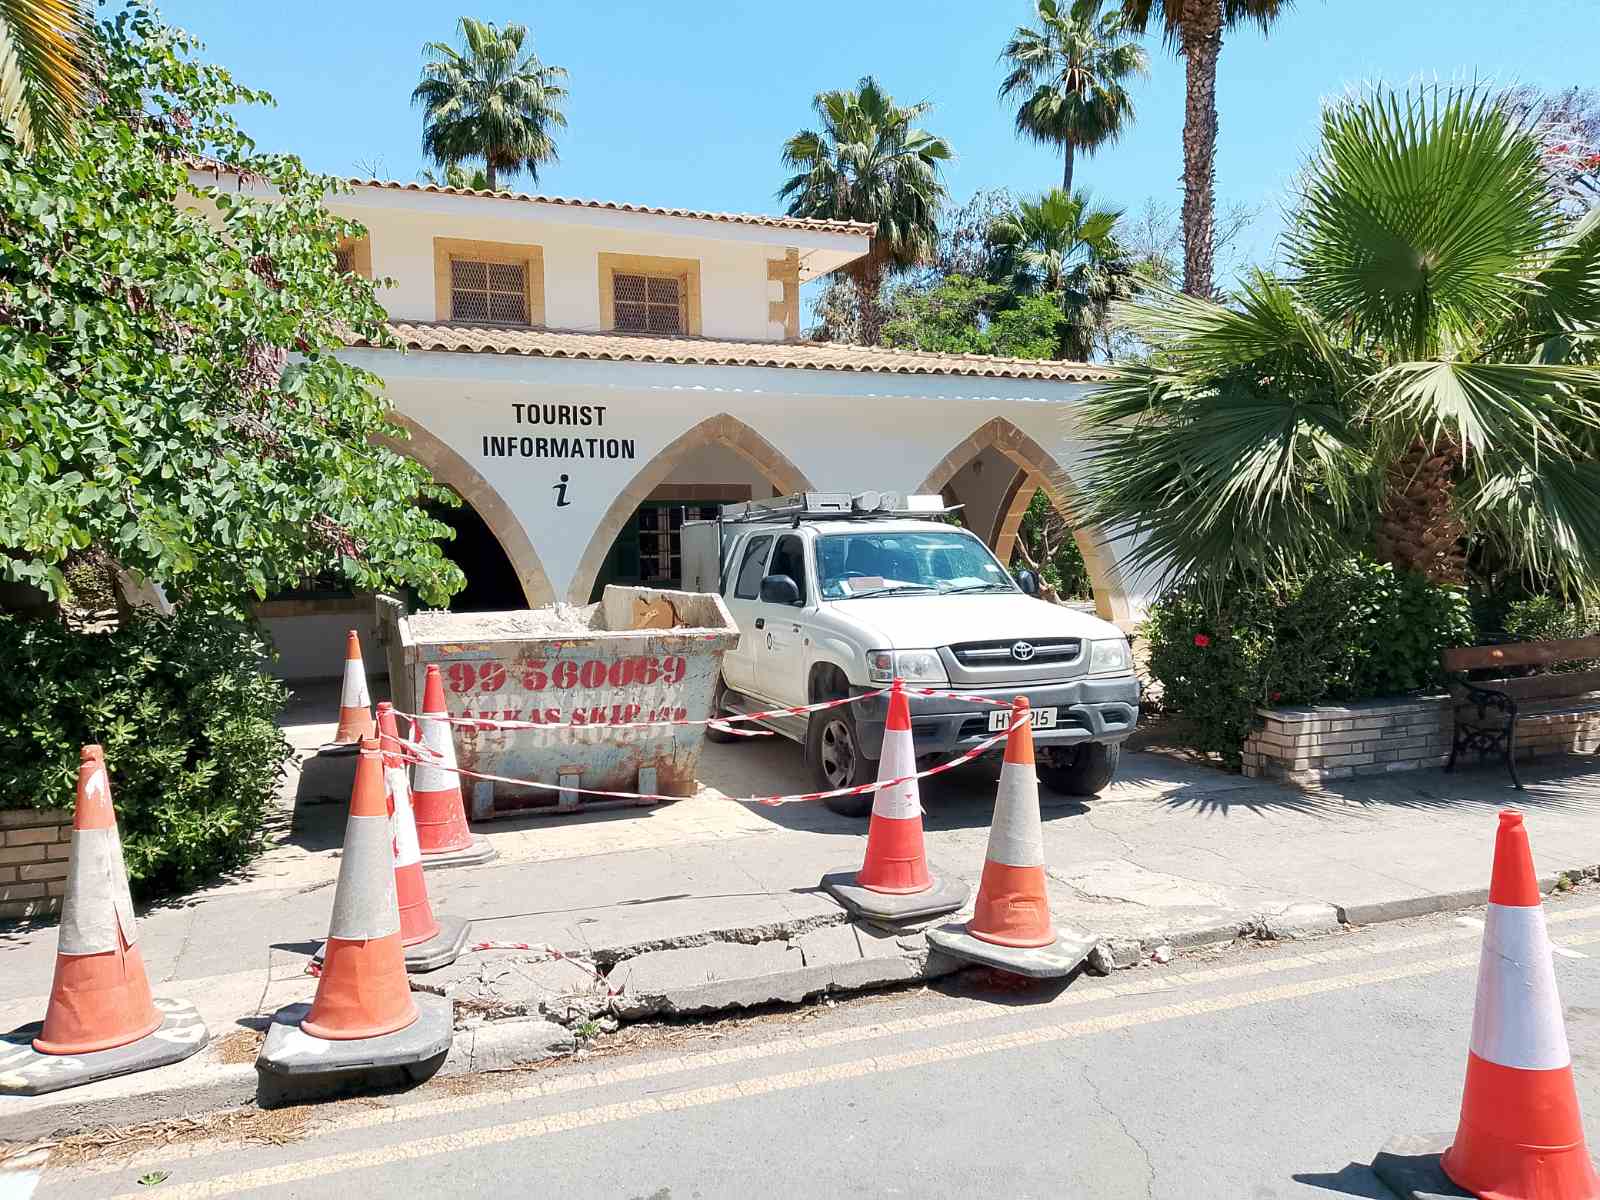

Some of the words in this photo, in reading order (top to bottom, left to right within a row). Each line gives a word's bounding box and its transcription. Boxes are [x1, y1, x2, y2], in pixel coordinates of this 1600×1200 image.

[512, 403, 606, 426] TOURIST
[483, 436, 635, 459] INFORMATION
[552, 474, 571, 507] i
[448, 661, 507, 693] 99
[522, 656, 686, 692] 560069
[570, 704, 641, 726] SKIP
